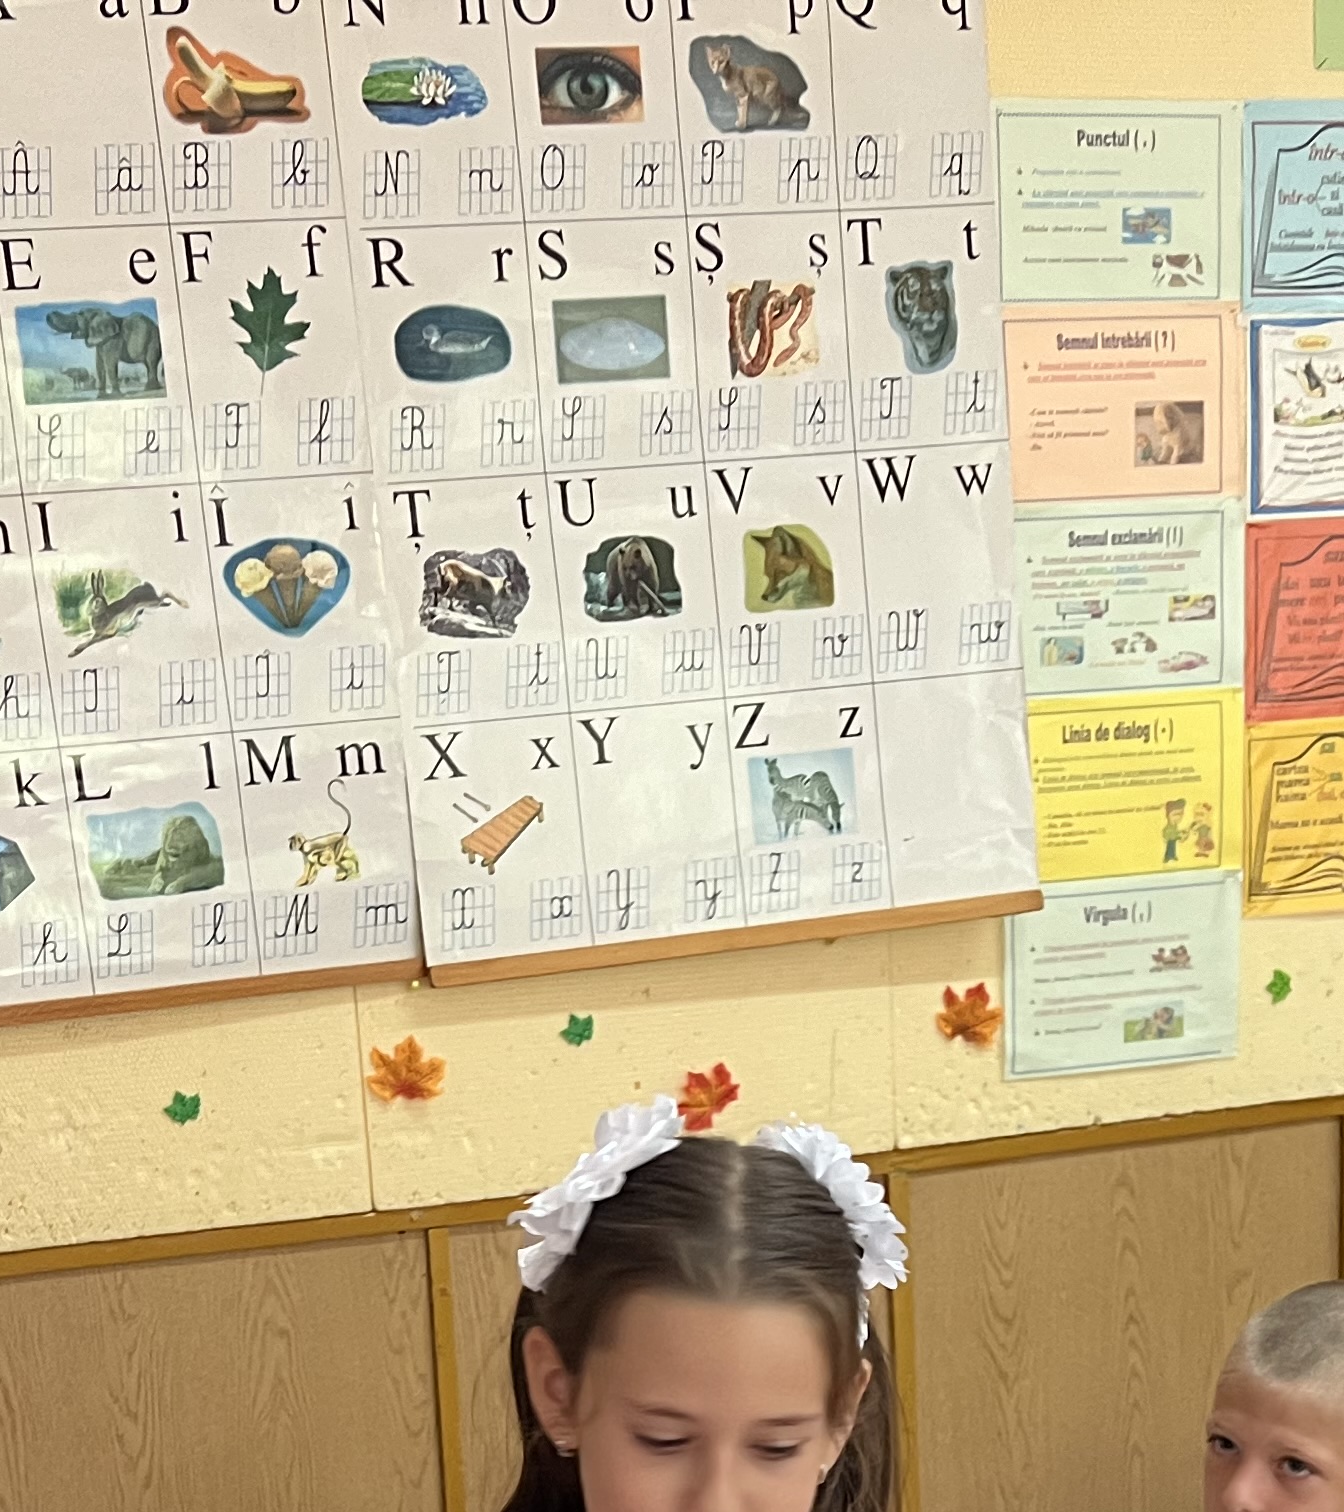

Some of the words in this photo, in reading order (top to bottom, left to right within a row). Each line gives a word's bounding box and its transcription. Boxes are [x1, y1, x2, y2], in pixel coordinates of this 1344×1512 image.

[790, 0, 812, 34] p
[942, 0, 970, 30] q
[1077, 128, 1130, 147] Punctul
[3, 141, 39, 195] Â
[110, 158, 142, 191] â
[183, 142, 209, 189] B
[283, 140, 309, 187] b
[375, 150, 409, 196] N
[469, 169, 503, 192] n
[541, 145, 564, 190] O
[636, 164, 659, 187] o
[702, 140, 724, 184] P
[788, 159, 819, 202] p
[855, 136, 879, 179] Q
[944, 153, 970, 195] q
[177, 231, 213, 283] F
[302, 225, 326, 276] f
[367, 238, 413, 288] R
[492, 248, 512, 281] r
[539, 230, 567, 280] S
[655, 242, 674, 275] s
[696, 223, 723, 284] Ș
[809, 234, 827, 276] ș
[846, 217, 882, 266] T
[963, 220, 979, 259] t
[130, 249, 156, 284] e
[562, 396, 581, 441] S
[655, 407, 672, 434] s
[880, 377, 901, 419] T
[967, 371, 985, 413] t
[37, 413, 62, 460] E
[139, 430, 159, 453] e
[225, 403, 249, 448] F
[310, 398, 330, 453] f
[401, 406, 433, 450] R
[498, 419, 524, 444] r
[556, 478, 596, 526] U
[671, 486, 697, 518] u
[713, 467, 752, 514] V
[819, 475, 842, 505] v
[865, 455, 916, 503] W
[955, 464, 991, 496] w
[32, 501, 57, 552] I
[171, 490, 189, 543] i
[210, 484, 234, 548] Î
[343, 482, 359, 531] î
[393, 490, 430, 552] Ț
[517, 489, 535, 539] ț
[740, 624, 767, 665] V
[823, 634, 848, 657] v
[888, 609, 924, 651] W
[970, 621, 1004, 643] w
[587, 638, 617, 680] U
[675, 650, 704, 672] u
[579, 717, 617, 765] Y
[687, 723, 713, 769] y
[734, 703, 768, 749] Z
[840, 707, 862, 738] z
[1062, 723, 1092, 744] Linia
[1095, 721, 1110, 742] de
[1113, 720, 1151, 744] dialog
[73, 754, 112, 803] L
[202, 742, 218, 789] l
[242, 735, 300, 786] M
[336, 743, 386, 776] m
[421, 731, 468, 781] X
[532, 737, 559, 769] x
[15, 766, 47, 807] k
[769, 853, 782, 892] Z
[852, 862, 863, 883] z
[275, 894, 317, 938] M
[366, 904, 407, 926] m
[452, 887, 474, 930] X
[551, 896, 572, 919] x
[607, 869, 634, 930] Y
[695, 878, 721, 920] y
[33, 922, 68, 965] k
[108, 914, 131, 957] L
[205, 903, 226, 946] l
